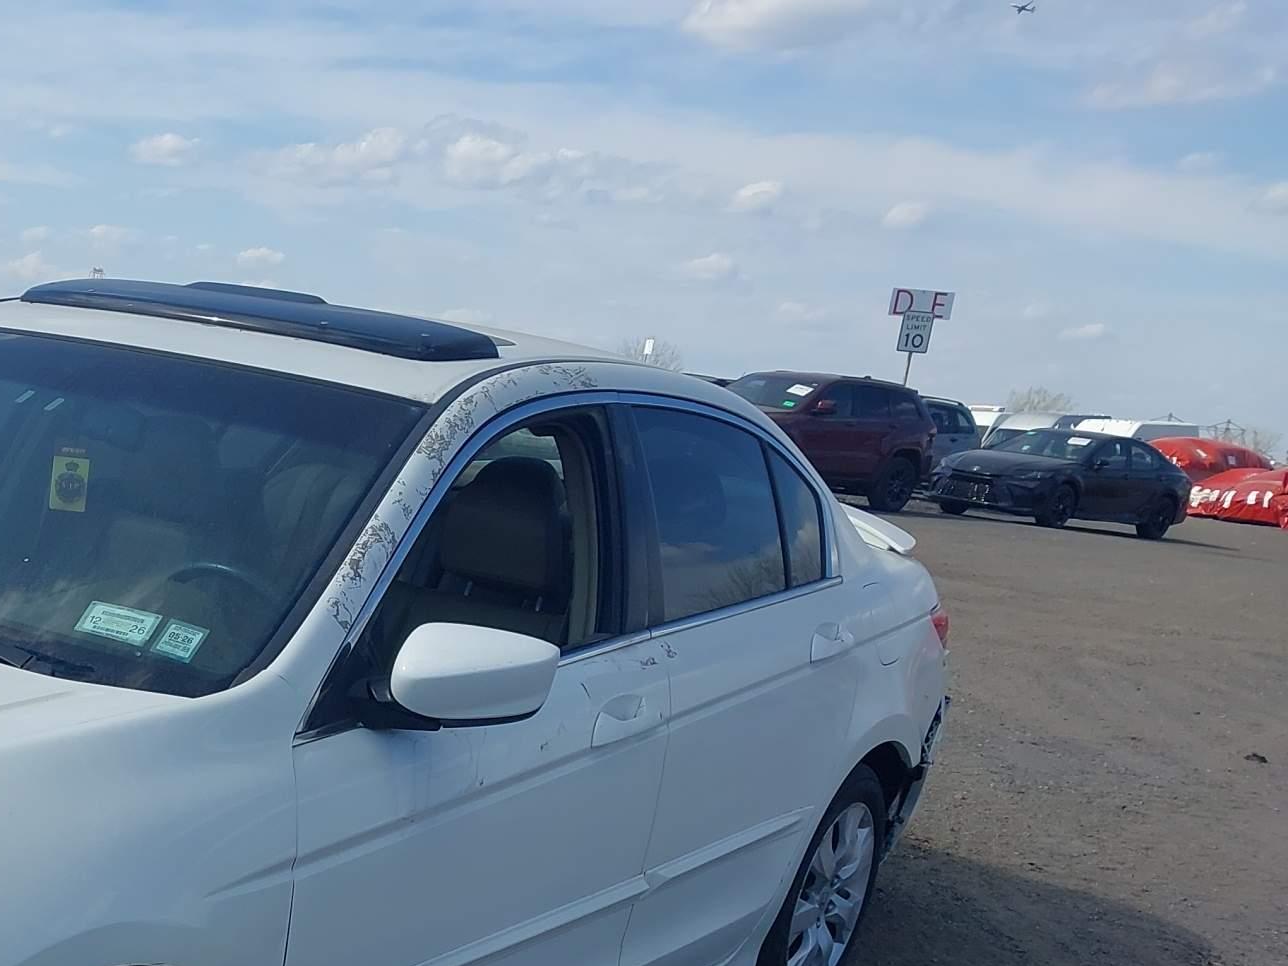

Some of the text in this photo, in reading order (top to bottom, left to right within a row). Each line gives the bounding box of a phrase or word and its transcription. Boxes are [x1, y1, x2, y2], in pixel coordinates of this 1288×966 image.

[893, 290, 948, 319] D E
[906, 314, 932, 322] SPEED
[904, 333, 924, 348] 10
[89, 615, 102, 625] 12
[128, 624, 145, 636] 26
